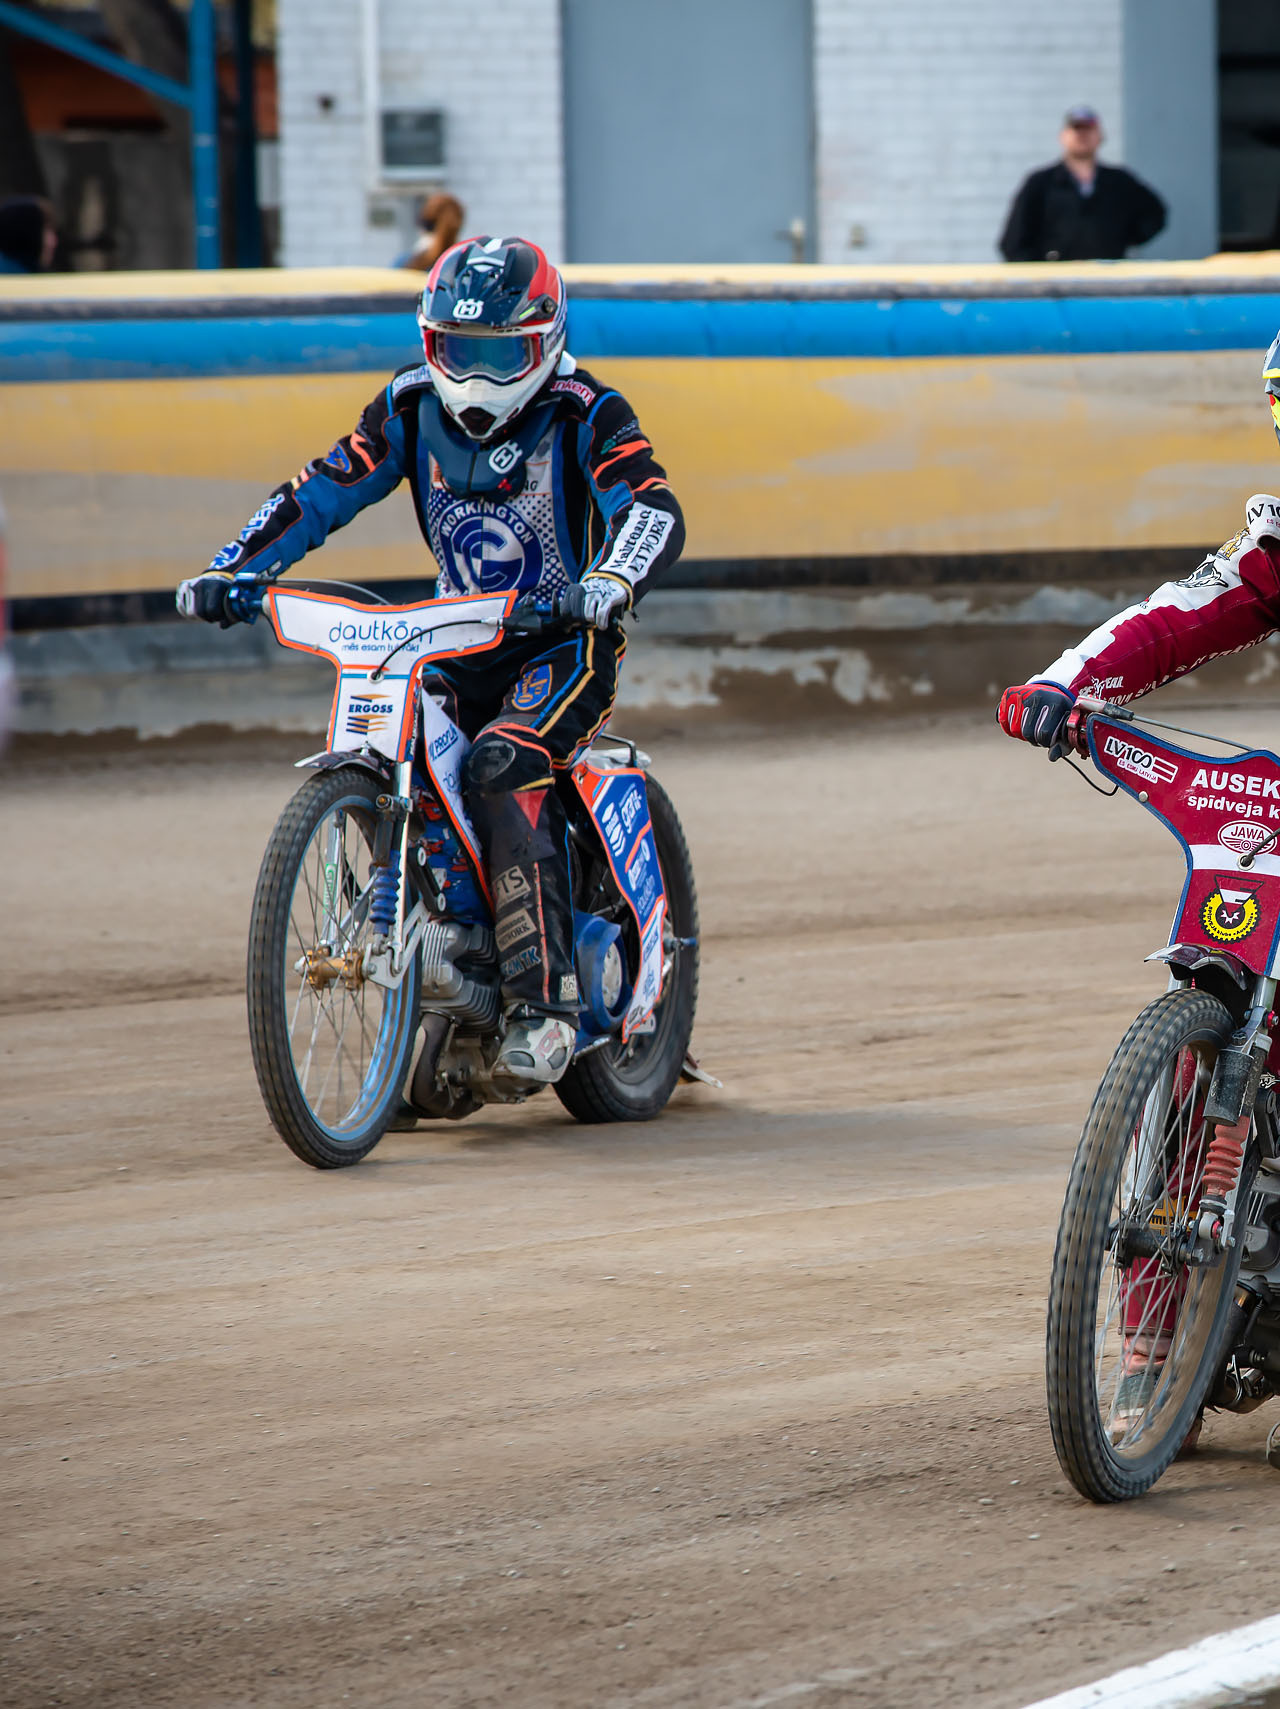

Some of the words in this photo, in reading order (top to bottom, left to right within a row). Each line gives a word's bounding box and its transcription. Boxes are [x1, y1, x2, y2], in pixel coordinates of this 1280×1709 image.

[441, 500, 534, 544] WORKINGTON
[347, 704, 394, 714] ERGOSS
[1187, 794, 1264, 818] spīdveja
[1230, 826, 1265, 841] JAWA
